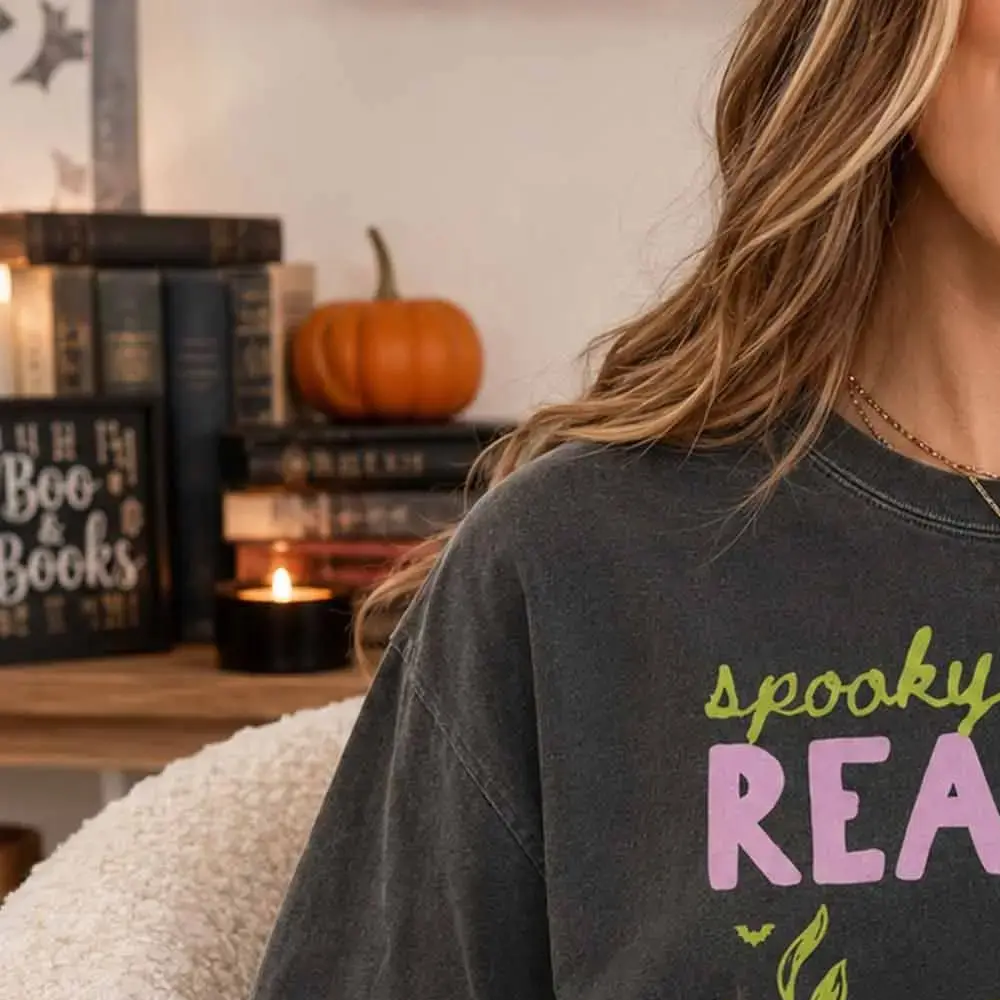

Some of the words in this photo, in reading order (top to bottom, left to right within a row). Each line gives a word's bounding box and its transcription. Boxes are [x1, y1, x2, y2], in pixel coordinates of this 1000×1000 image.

[1, 451, 102, 525] Boo
[0, 509, 147, 607] Books
[37, 509, 66, 546] &
